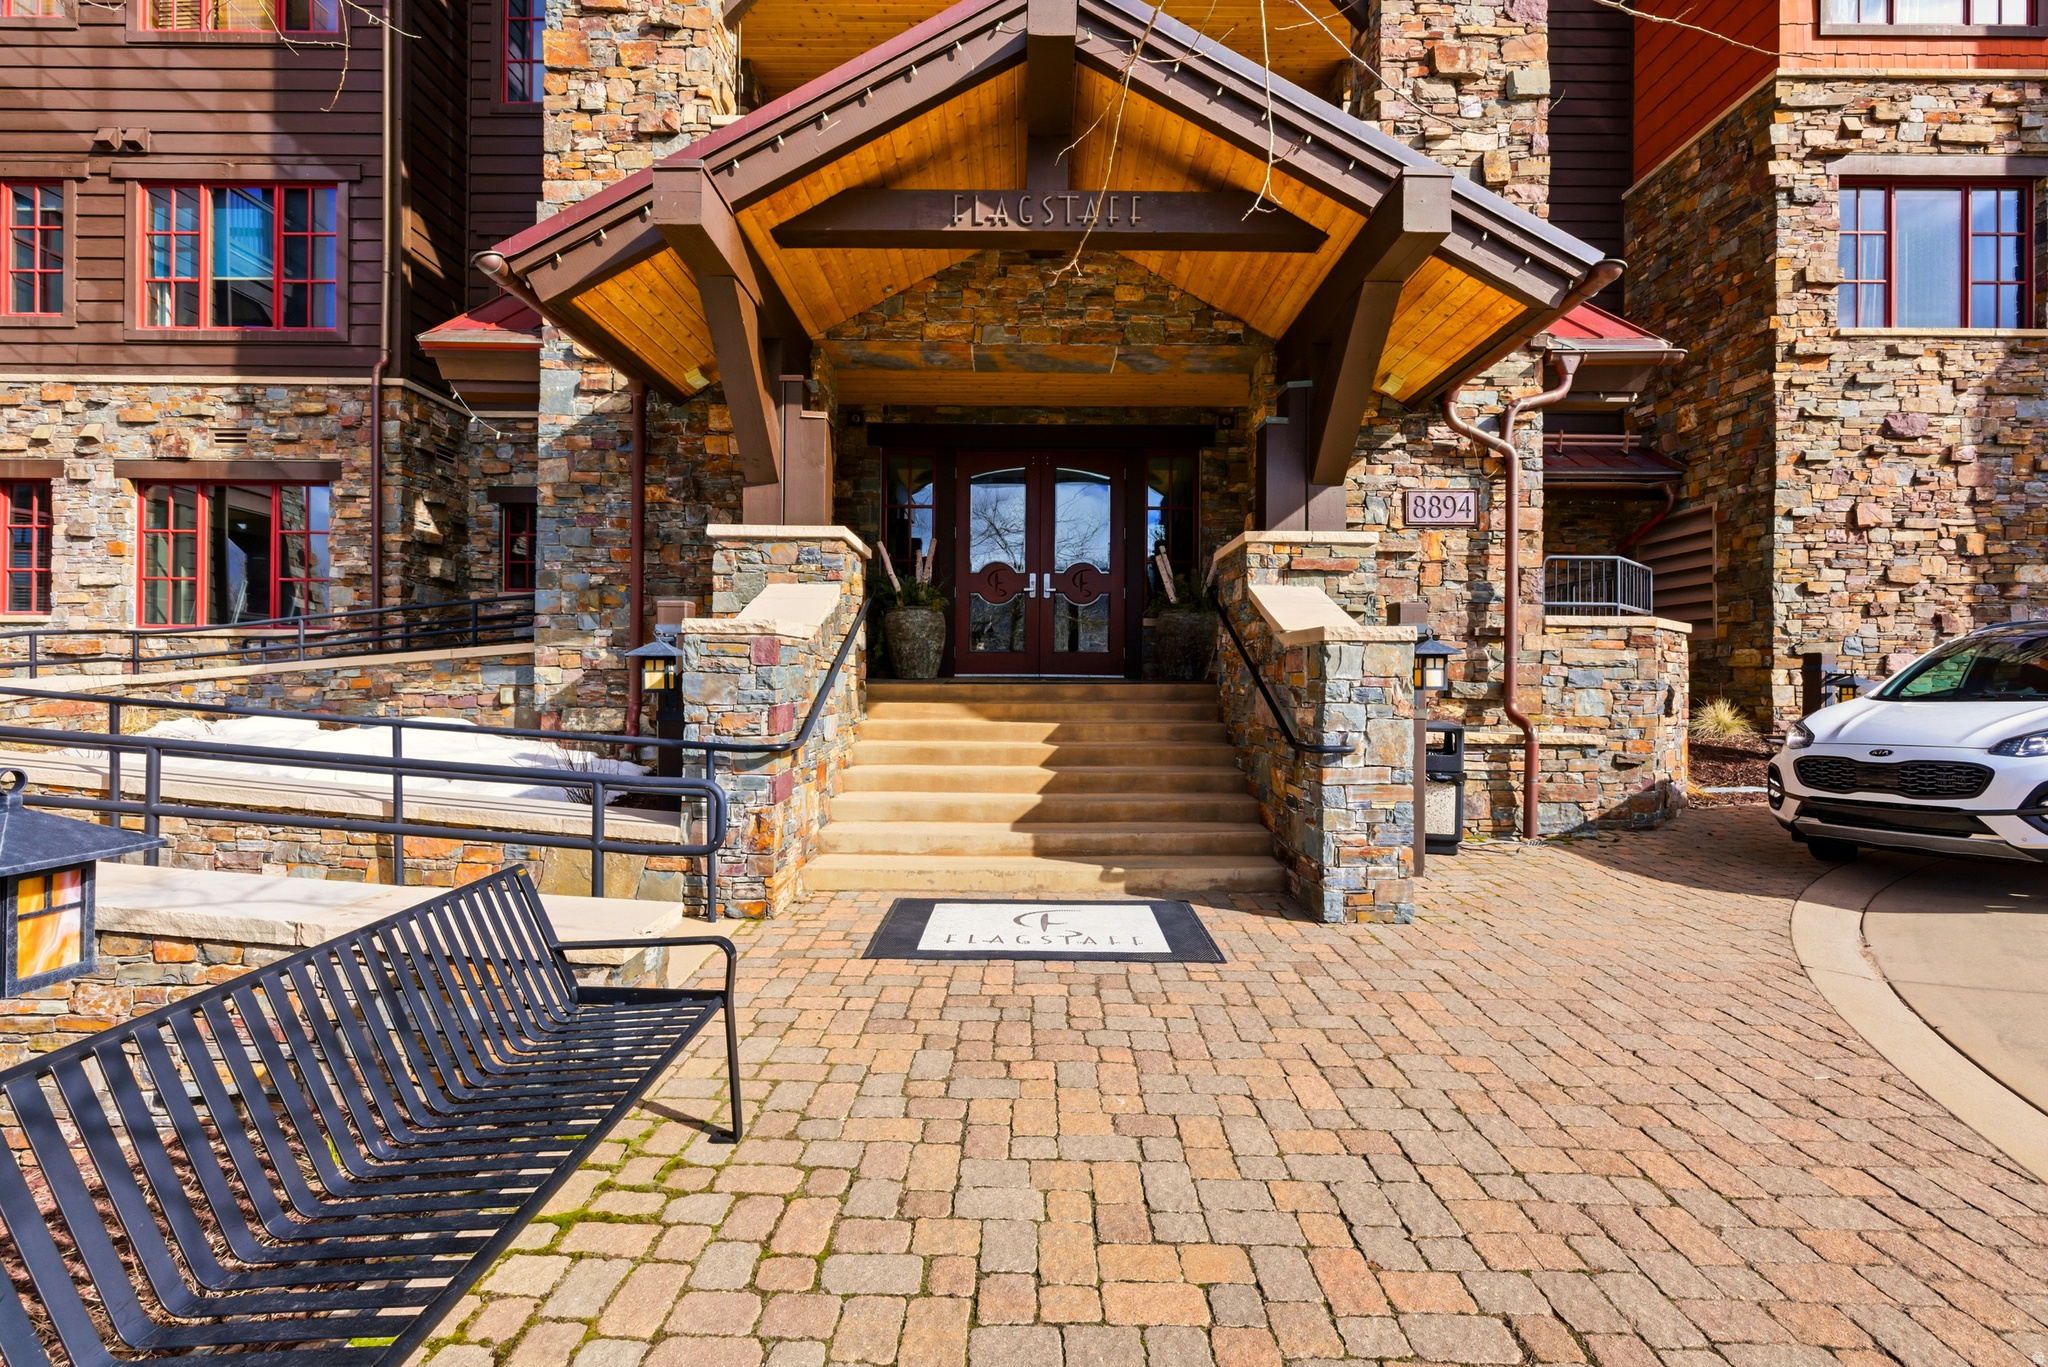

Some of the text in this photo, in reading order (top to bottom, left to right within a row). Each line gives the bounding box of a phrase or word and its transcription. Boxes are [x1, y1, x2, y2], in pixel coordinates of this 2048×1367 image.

[952, 194, 1142, 227] FLAGSTAFF
[1412, 495, 1472, 519] 8894
[943, 933, 1144, 946] FLAGSTAFF
